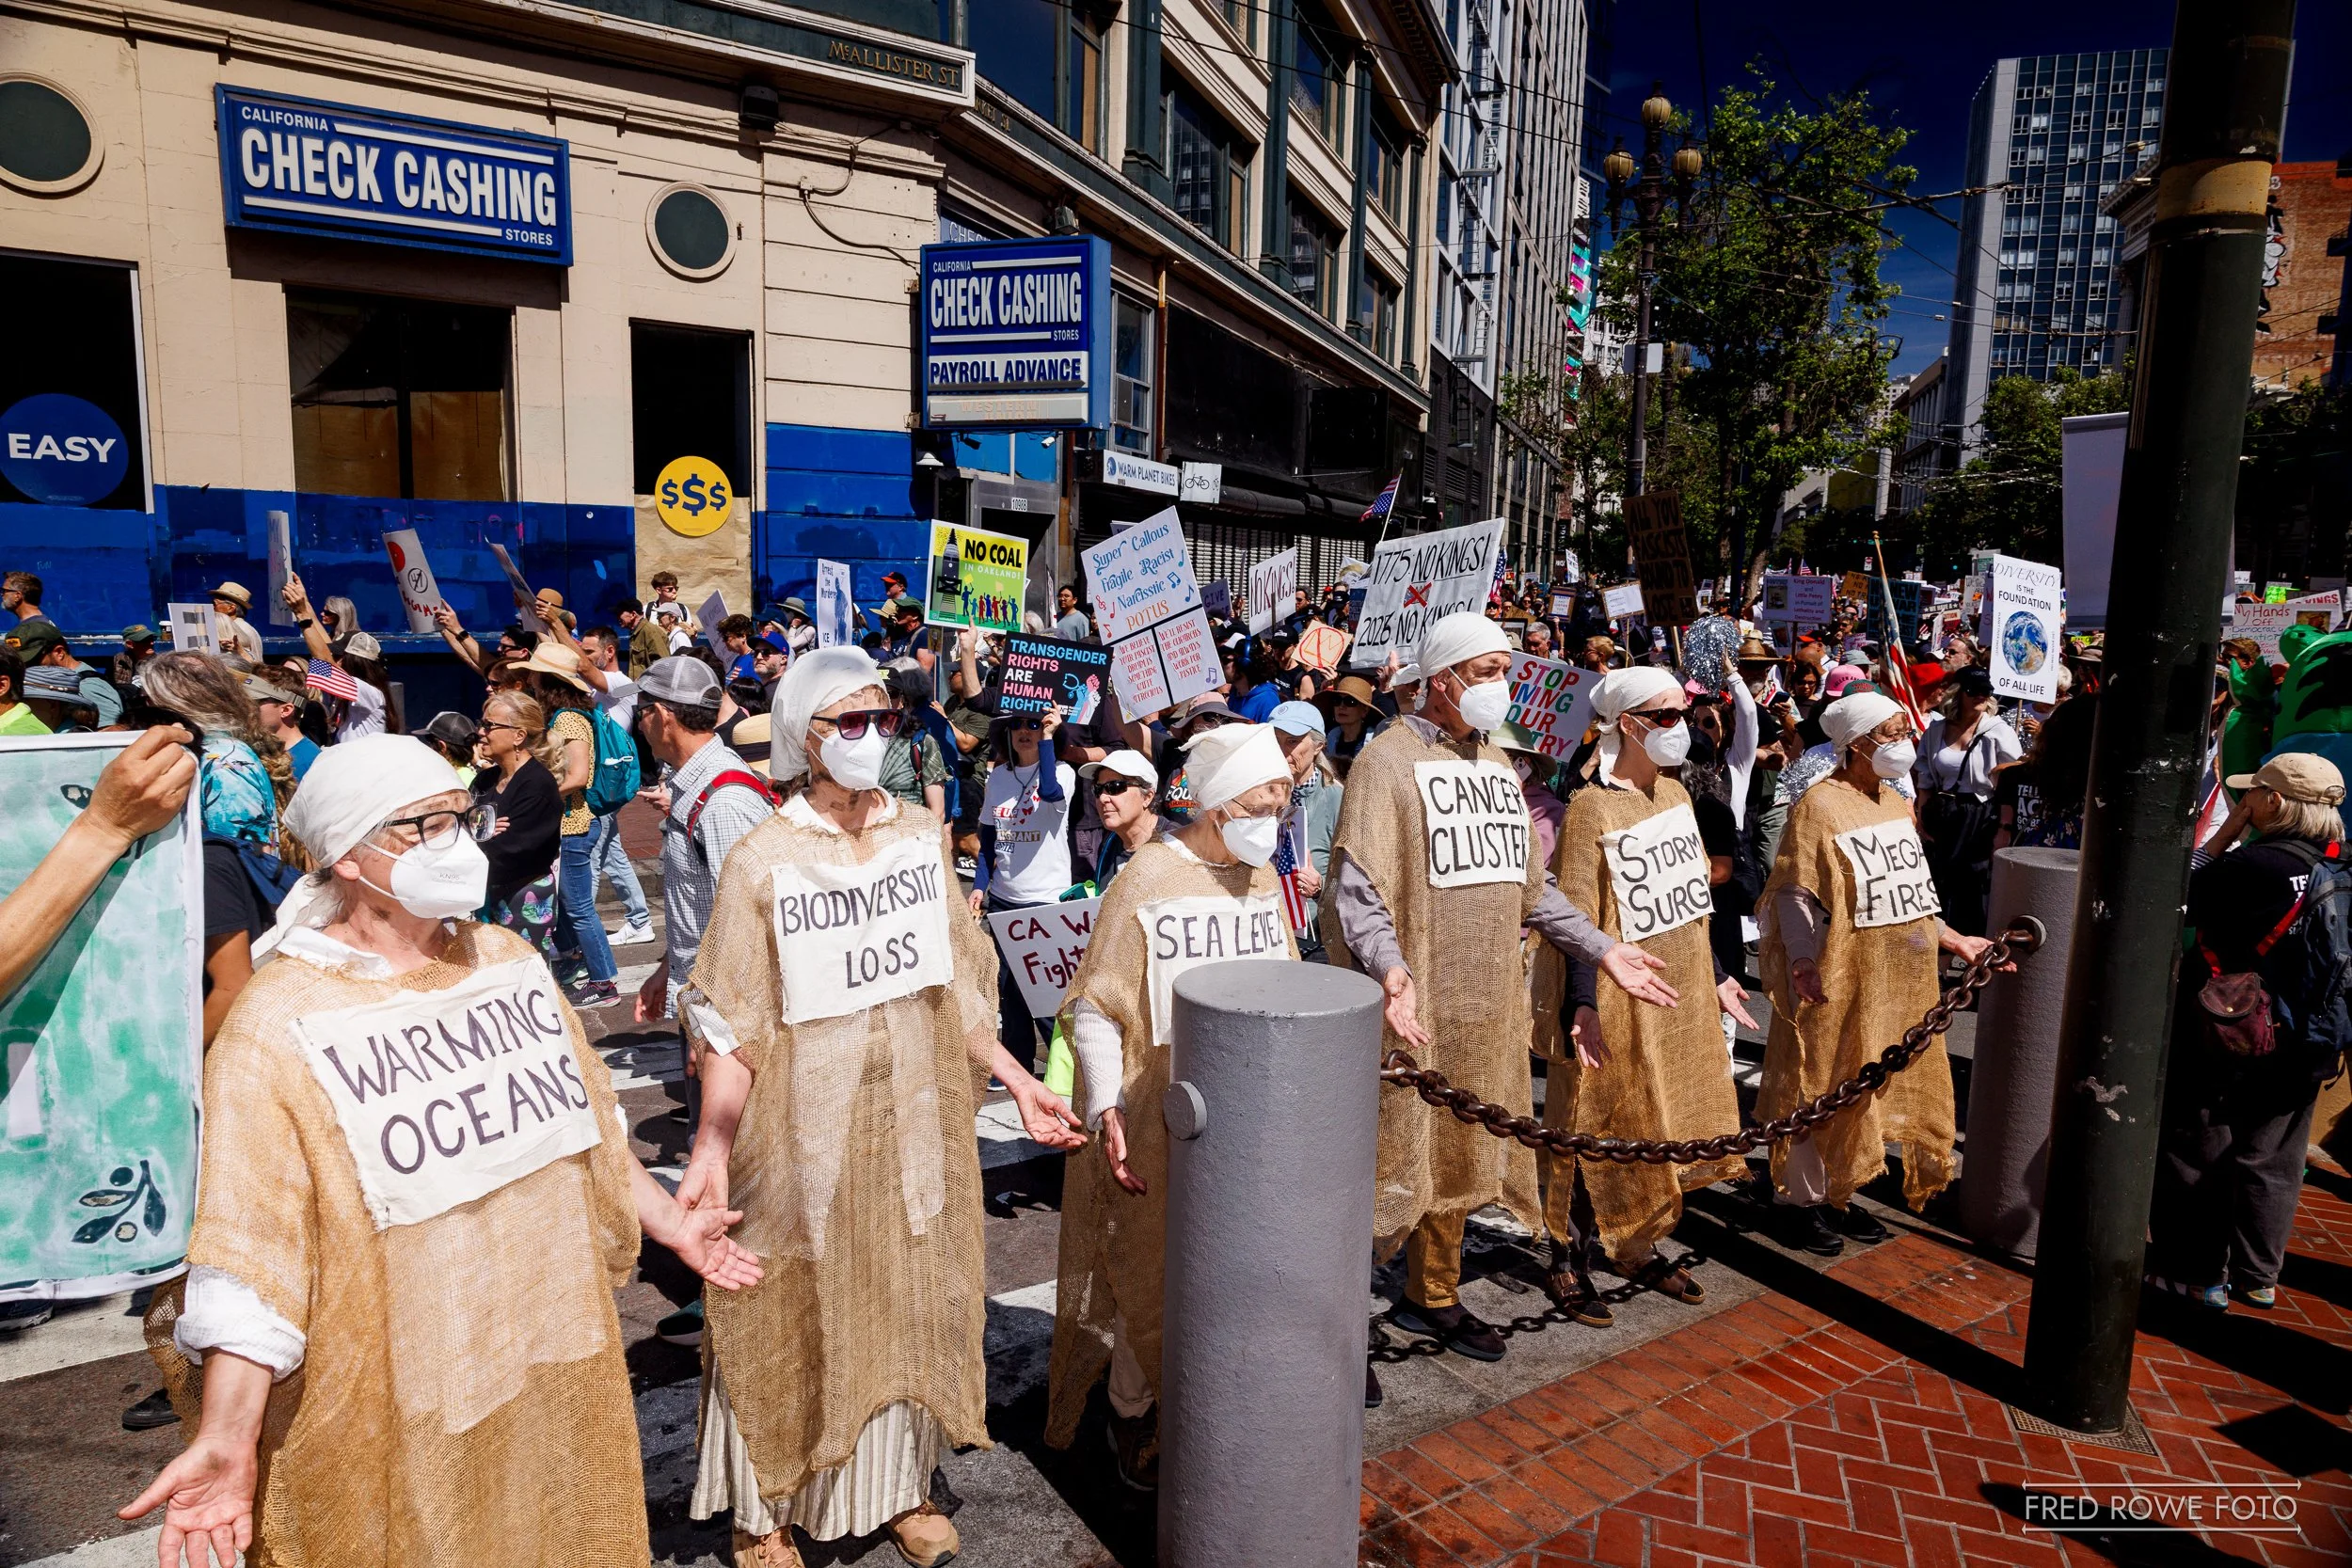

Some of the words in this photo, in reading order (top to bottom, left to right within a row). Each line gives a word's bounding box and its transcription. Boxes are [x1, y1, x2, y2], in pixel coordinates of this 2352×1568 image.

[938, 67, 959, 87] ST.
[242, 106, 329, 132] CALIFORNIA
[241, 128, 383, 204] CHECK
[394, 150, 557, 228] CASHING
[505, 229, 553, 245] STORES
[933, 261, 971, 273] CALIFORNIA
[930, 277, 993, 328] CHECK
[998, 272, 1082, 325] CASHING
[1053, 329, 1079, 341] STORES
[930, 360, 999, 384] PAYROLL
[1004, 358, 1081, 382] ADVANCE
[8, 434, 116, 463] EASY
[1118, 462, 1136, 477] WARM
[1137, 466, 1159, 483] PLANET
[1160, 471, 1176, 487] BIKES
[1629, 500, 1653, 532] ALL
[1651, 496, 1679, 529] YOU
[964, 538, 987, 562] NO
[990, 544, 1023, 568] COAL
[1092, 540, 1127, 576] Super
[1131, 524, 1169, 551] Callous
[1411, 544, 1437, 582] NO
[1433, 532, 1492, 580] KINGS!
[964, 562, 974, 572] IN
[977, 564, 1021, 580] OAKLAND!
[1101, 568, 1134, 594] Fragile
[1138, 548, 1175, 576] Racist
[1994, 562, 2056, 587] DIVERSITY
[1204, 589, 1224, 609] GIVE
[1998, 591, 2051, 610] FOUNDATION
[2024, 586, 2034, 594] THE
[1125, 599, 1169, 631] POTUS
[1175, 619, 1196, 636] RESIST
[1395, 610, 1419, 645] NO
[2234, 605, 2250, 626] My
[2252, 605, 2290, 617] Hands
[1008, 654, 1059, 672] RIGHTS
[1010, 640, 1107, 665] TRANSGENDER
[1005, 668, 1034, 683] ARE
[1518, 660, 1580, 691] STOP
[1999, 677, 2010, 688] OF
[2012, 680, 2026, 691] ALL
[2029, 684, 2044, 695] LIFE
[1002, 682, 1053, 700] HUMAN
[1429, 775, 1525, 816] CANCER
[1618, 832, 1701, 883] STORM
[780, 863, 937, 937] BIODIVERSITY
[1629, 874, 1710, 933] SURG
[1866, 875, 1941, 921] FIRES
[1008, 917, 1052, 941] CA
[1156, 914, 1224, 960] SEA
[845, 931, 919, 989] LOSS
[581, 993, 600, 1004] HOKA
[322, 990, 563, 1104] WARMING
[381, 1054, 589, 1175] OCEANS
